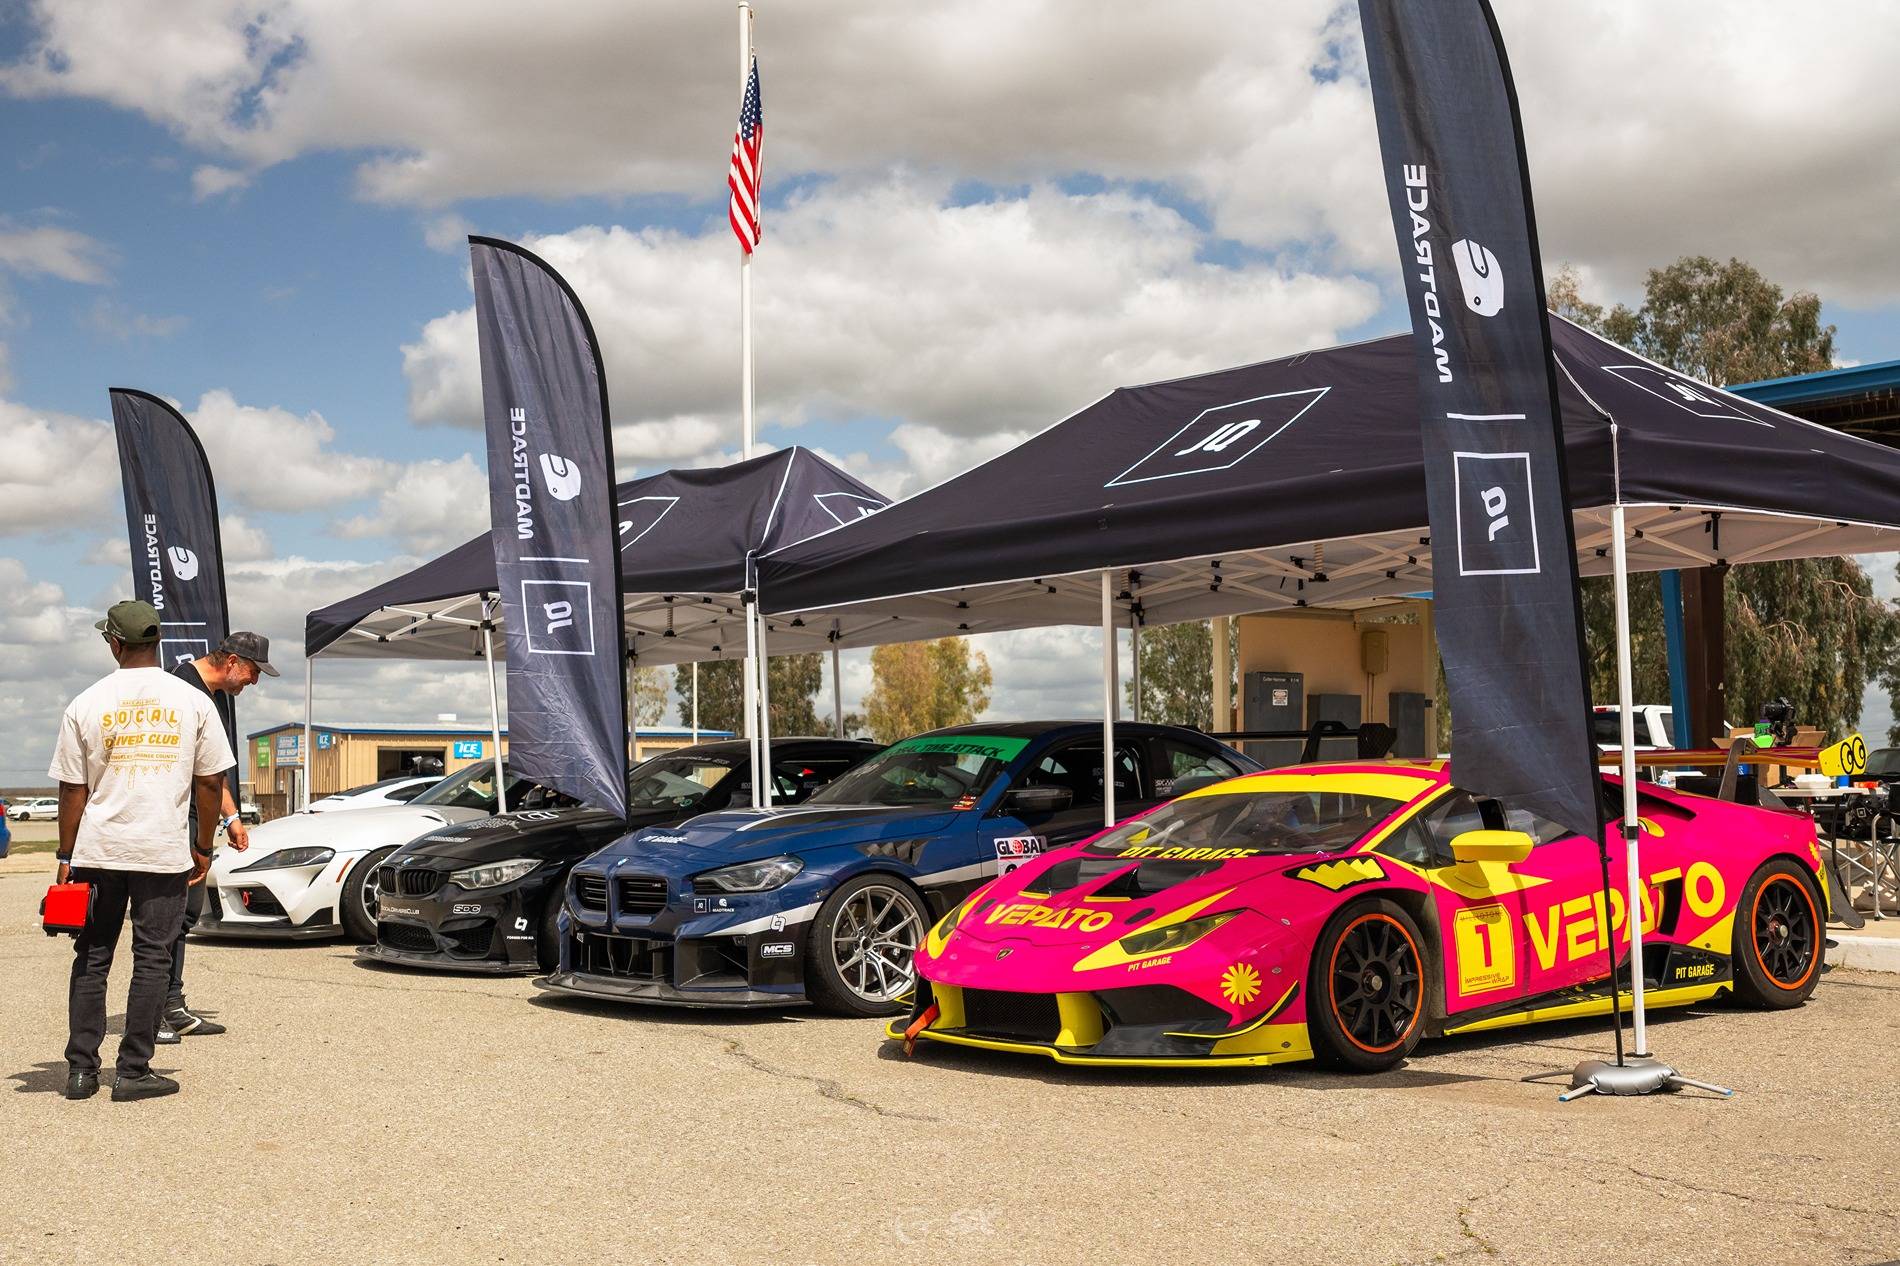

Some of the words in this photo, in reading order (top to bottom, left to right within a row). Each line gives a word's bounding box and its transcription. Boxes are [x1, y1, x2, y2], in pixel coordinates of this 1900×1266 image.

[148, 734, 179, 745] CLUB
[949, 744, 1005, 757] ATTACK
[996, 838, 1046, 855] GLOBAL
[1157, 847, 1260, 859] GARAGE
[984, 903, 1114, 933] VEPATO
[763, 945, 793, 954] MCS
[1475, 924, 1493, 967] 1
[1127, 962, 1141, 972] PIT
[1141, 956, 1173, 969] GARAGE
[1675, 967, 1687, 979] PIT
[1687, 964, 1715, 978] GARAGE
